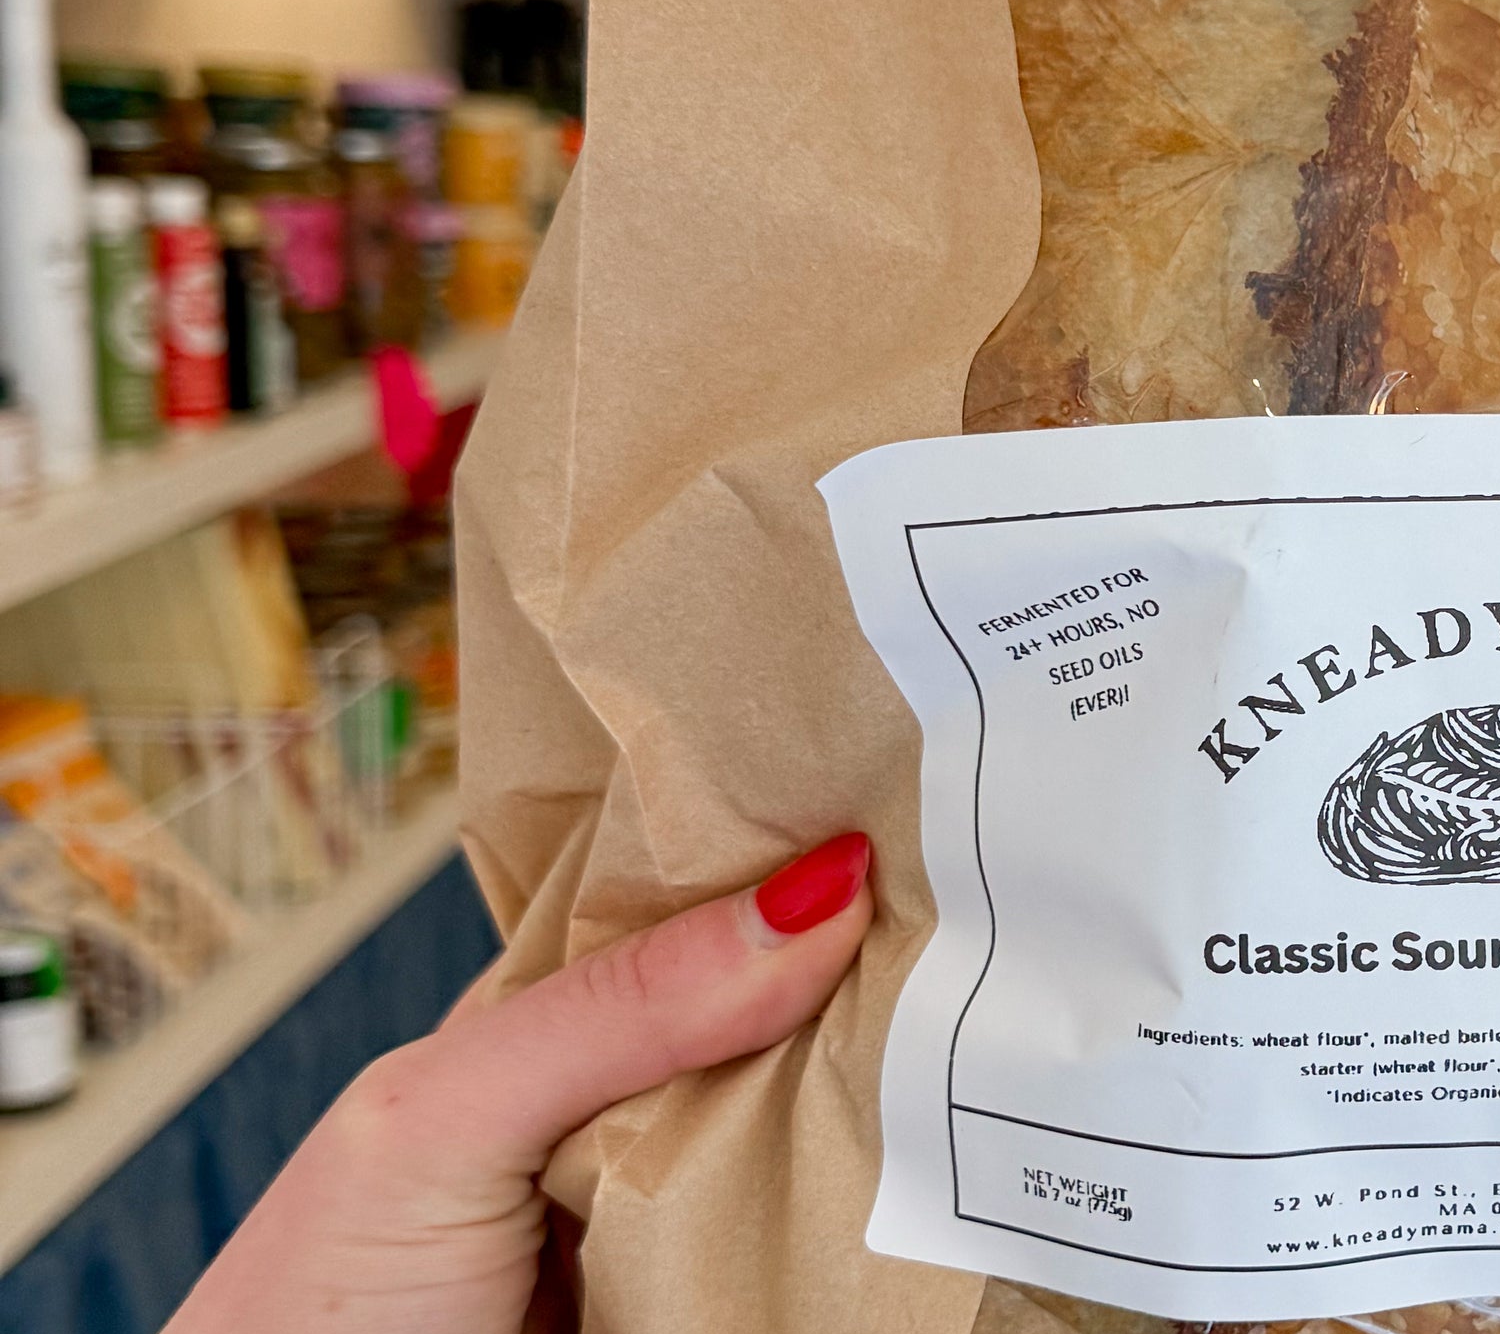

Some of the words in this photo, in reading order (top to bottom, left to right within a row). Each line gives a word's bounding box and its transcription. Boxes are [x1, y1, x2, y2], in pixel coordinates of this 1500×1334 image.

[978, 584, 1100, 635] FERMENTED
[1101, 568, 1149, 592] FOR
[1005, 637, 1042, 661] 24+
[1047, 611, 1124, 647] HOURS,
[1125, 599, 1160, 623] NO
[1049, 657, 1094, 685] SEED
[1099, 642, 1143, 670] OILS
[1203, 932, 1379, 975] Classic
[1137, 1022, 1244, 1049] Ingredients:
[1252, 1031, 1309, 1048] wheat
[1384, 1030, 1450, 1046] malted
[1300, 1061, 1364, 1076] starter
[1023, 1167, 1054, 1186] NET
[1059, 1175, 1128, 1202] WEIGHT
[1034, 1183, 1047, 1198] lb
[1273, 1197, 1301, 1212] 52
[1360, 1185, 1420, 1202] Pond
[1439, 1203, 1476, 1216] MA
